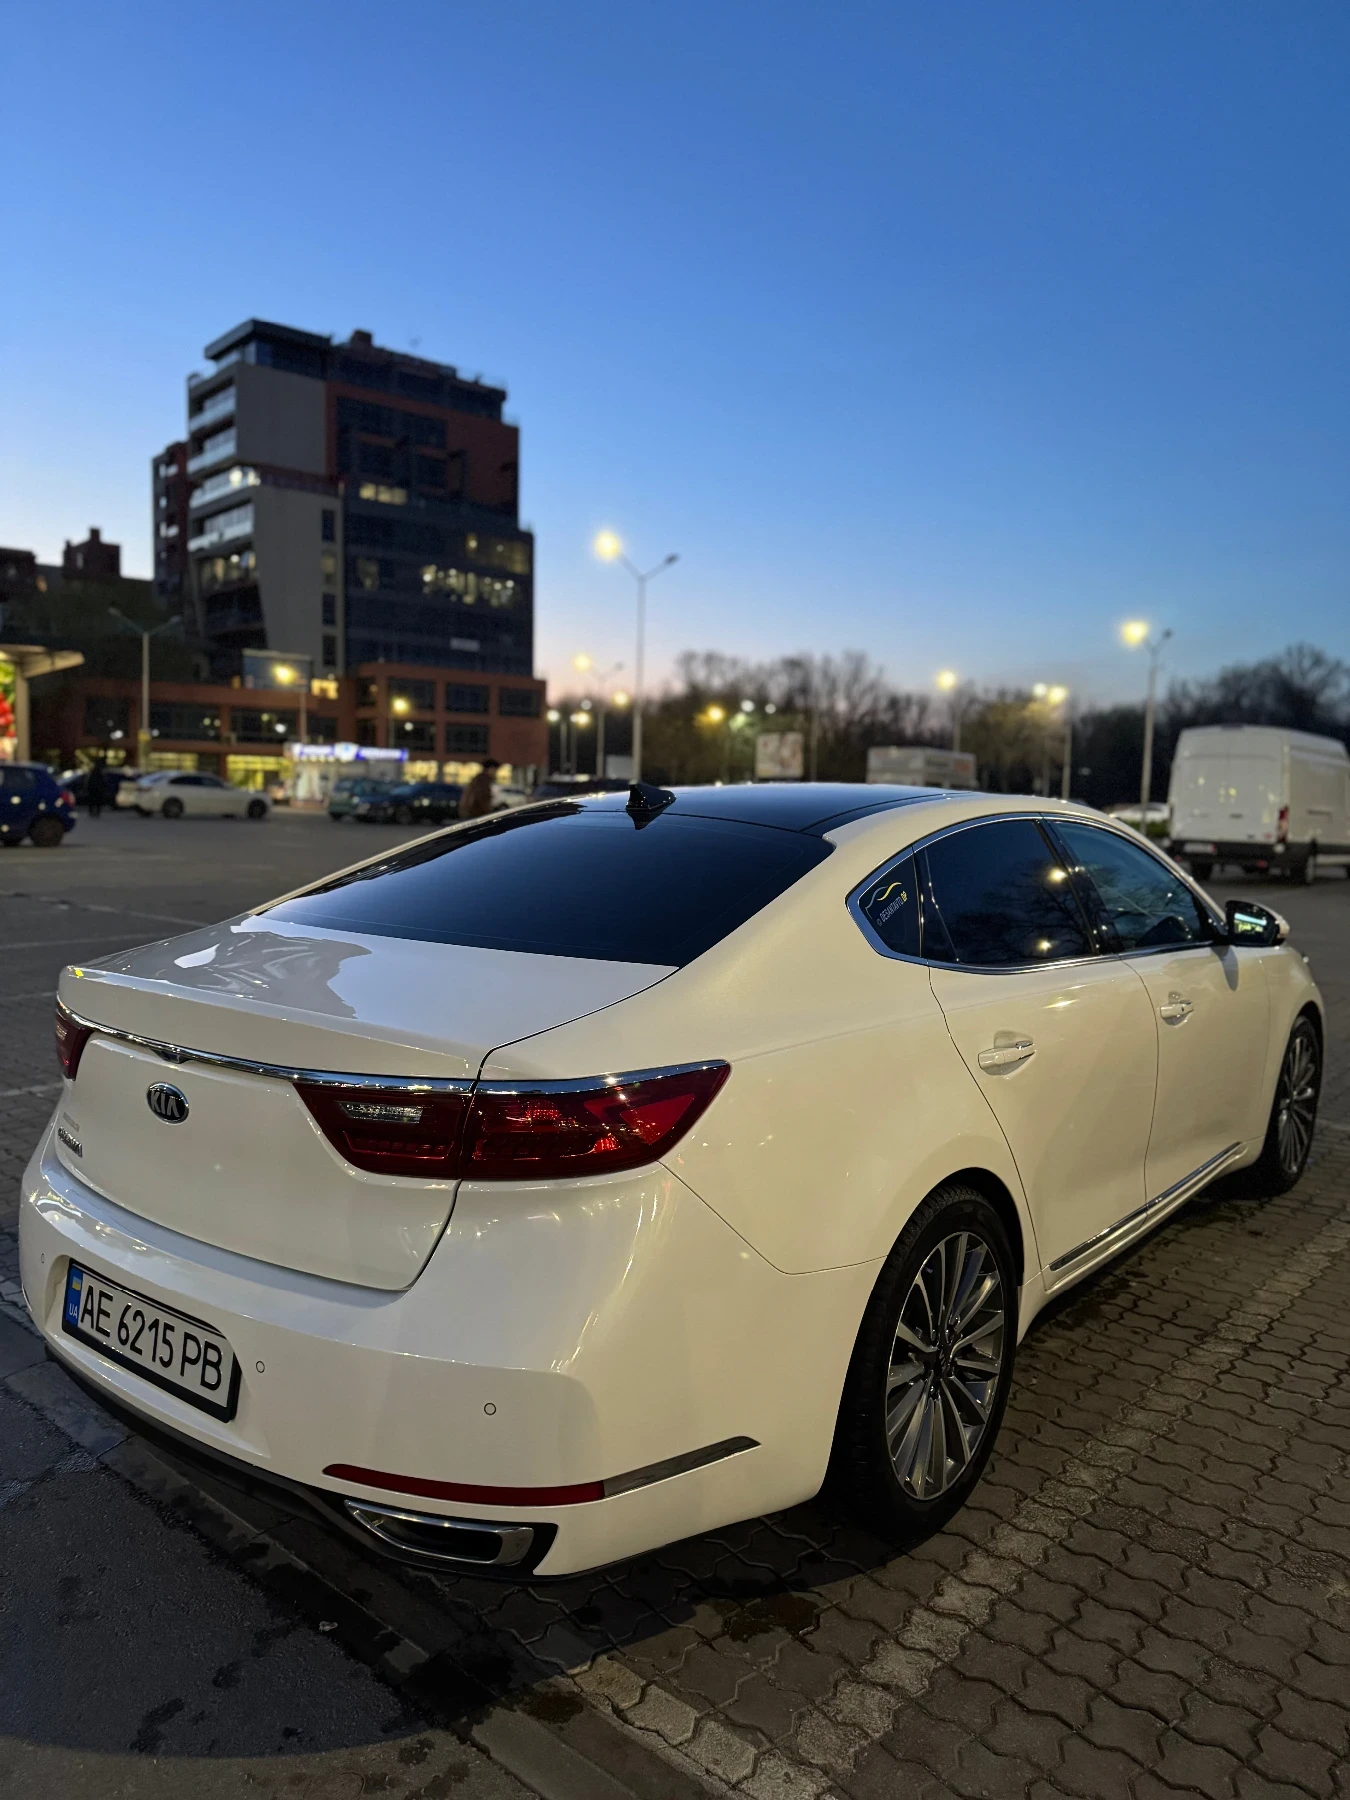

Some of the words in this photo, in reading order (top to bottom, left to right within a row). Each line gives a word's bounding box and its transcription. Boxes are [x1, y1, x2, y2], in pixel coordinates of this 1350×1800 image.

[150, 1089, 181, 1118] KIA
[69, 1303, 78, 1320] UA
[80, 1284, 114, 1338] AE
[117, 1302, 176, 1368] 6215
[179, 1331, 223, 1391] PB
